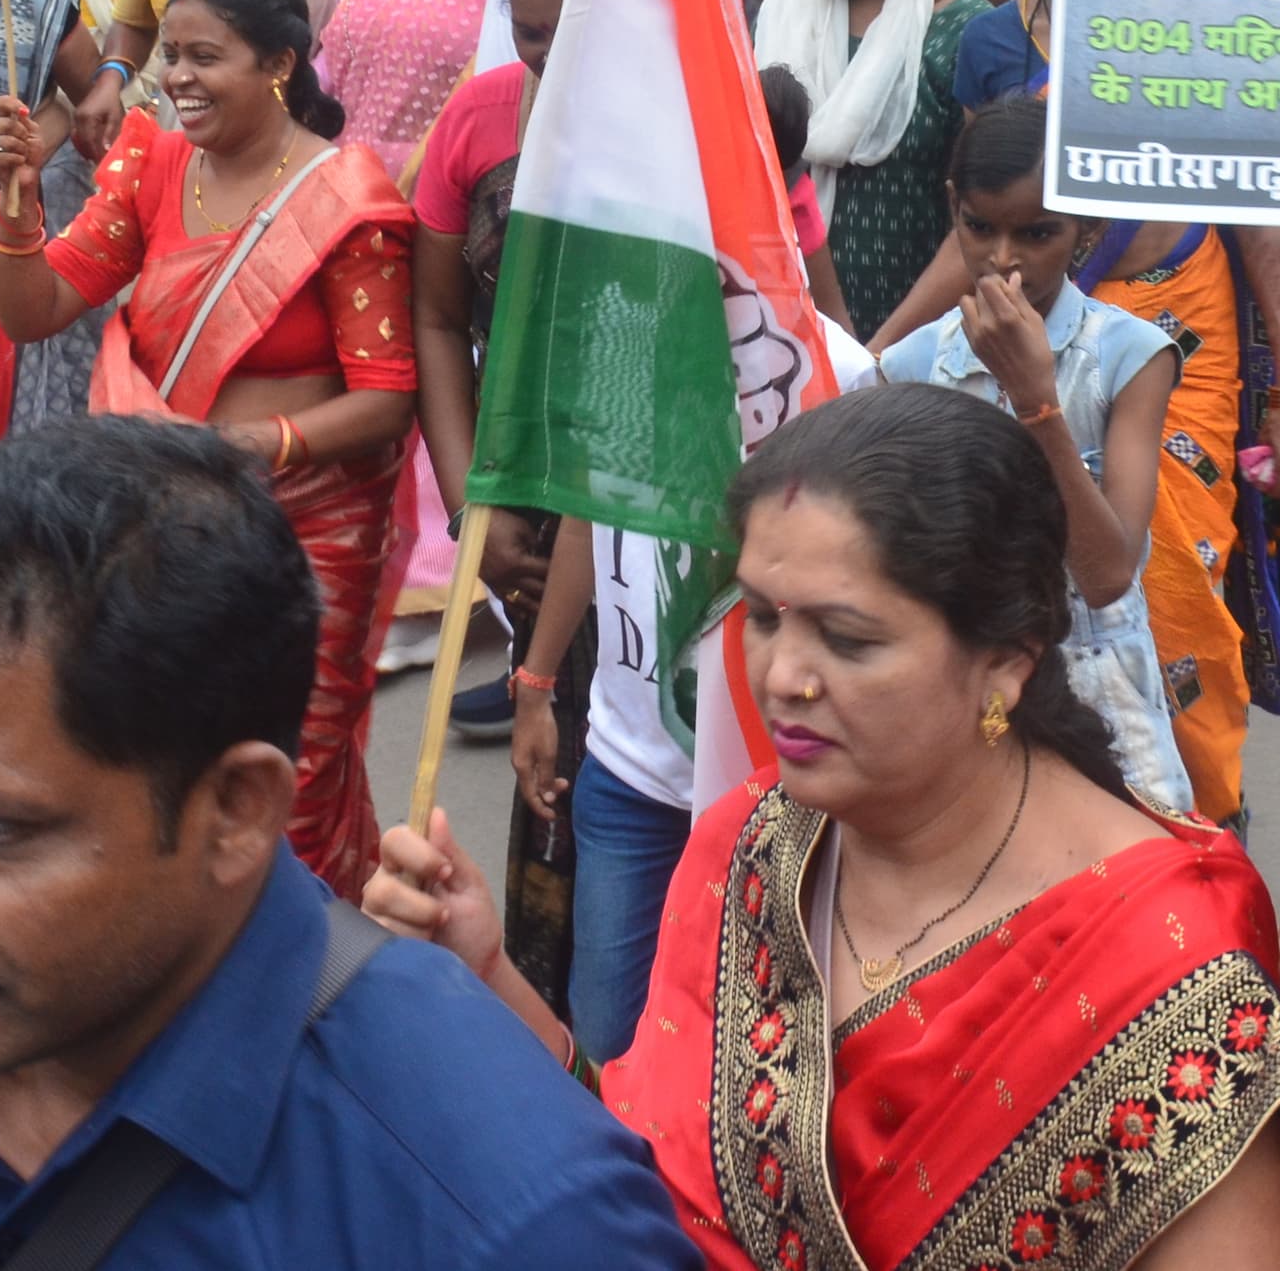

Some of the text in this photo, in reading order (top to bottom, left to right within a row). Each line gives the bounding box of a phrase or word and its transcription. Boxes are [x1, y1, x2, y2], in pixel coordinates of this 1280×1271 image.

[1087, 15, 1193, 55] 3094
[1089, 61, 1133, 104] के
[1140, 77, 1228, 109] साथ
